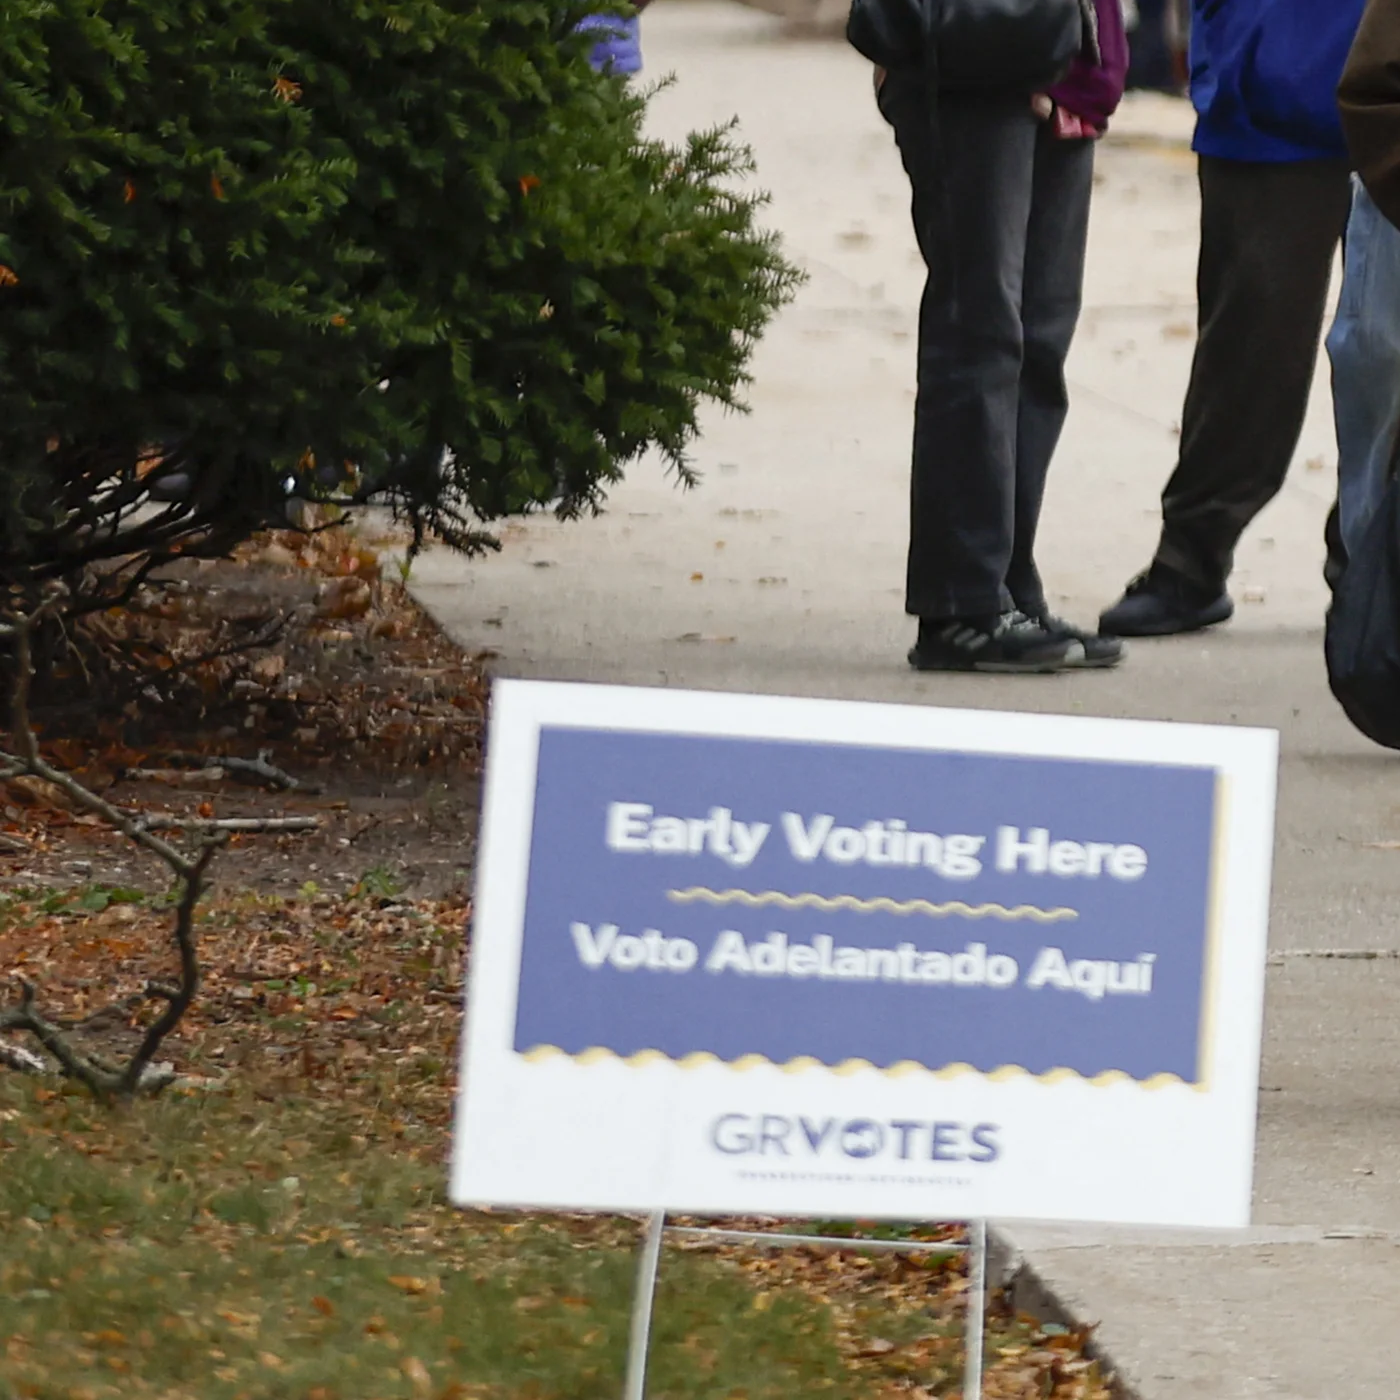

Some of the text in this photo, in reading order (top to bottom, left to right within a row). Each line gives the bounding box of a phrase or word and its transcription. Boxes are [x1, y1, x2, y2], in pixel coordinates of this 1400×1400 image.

[606, 801, 1149, 880] Early Voting Here
[571, 921, 1157, 1000] Voto Adelantado Aquí
